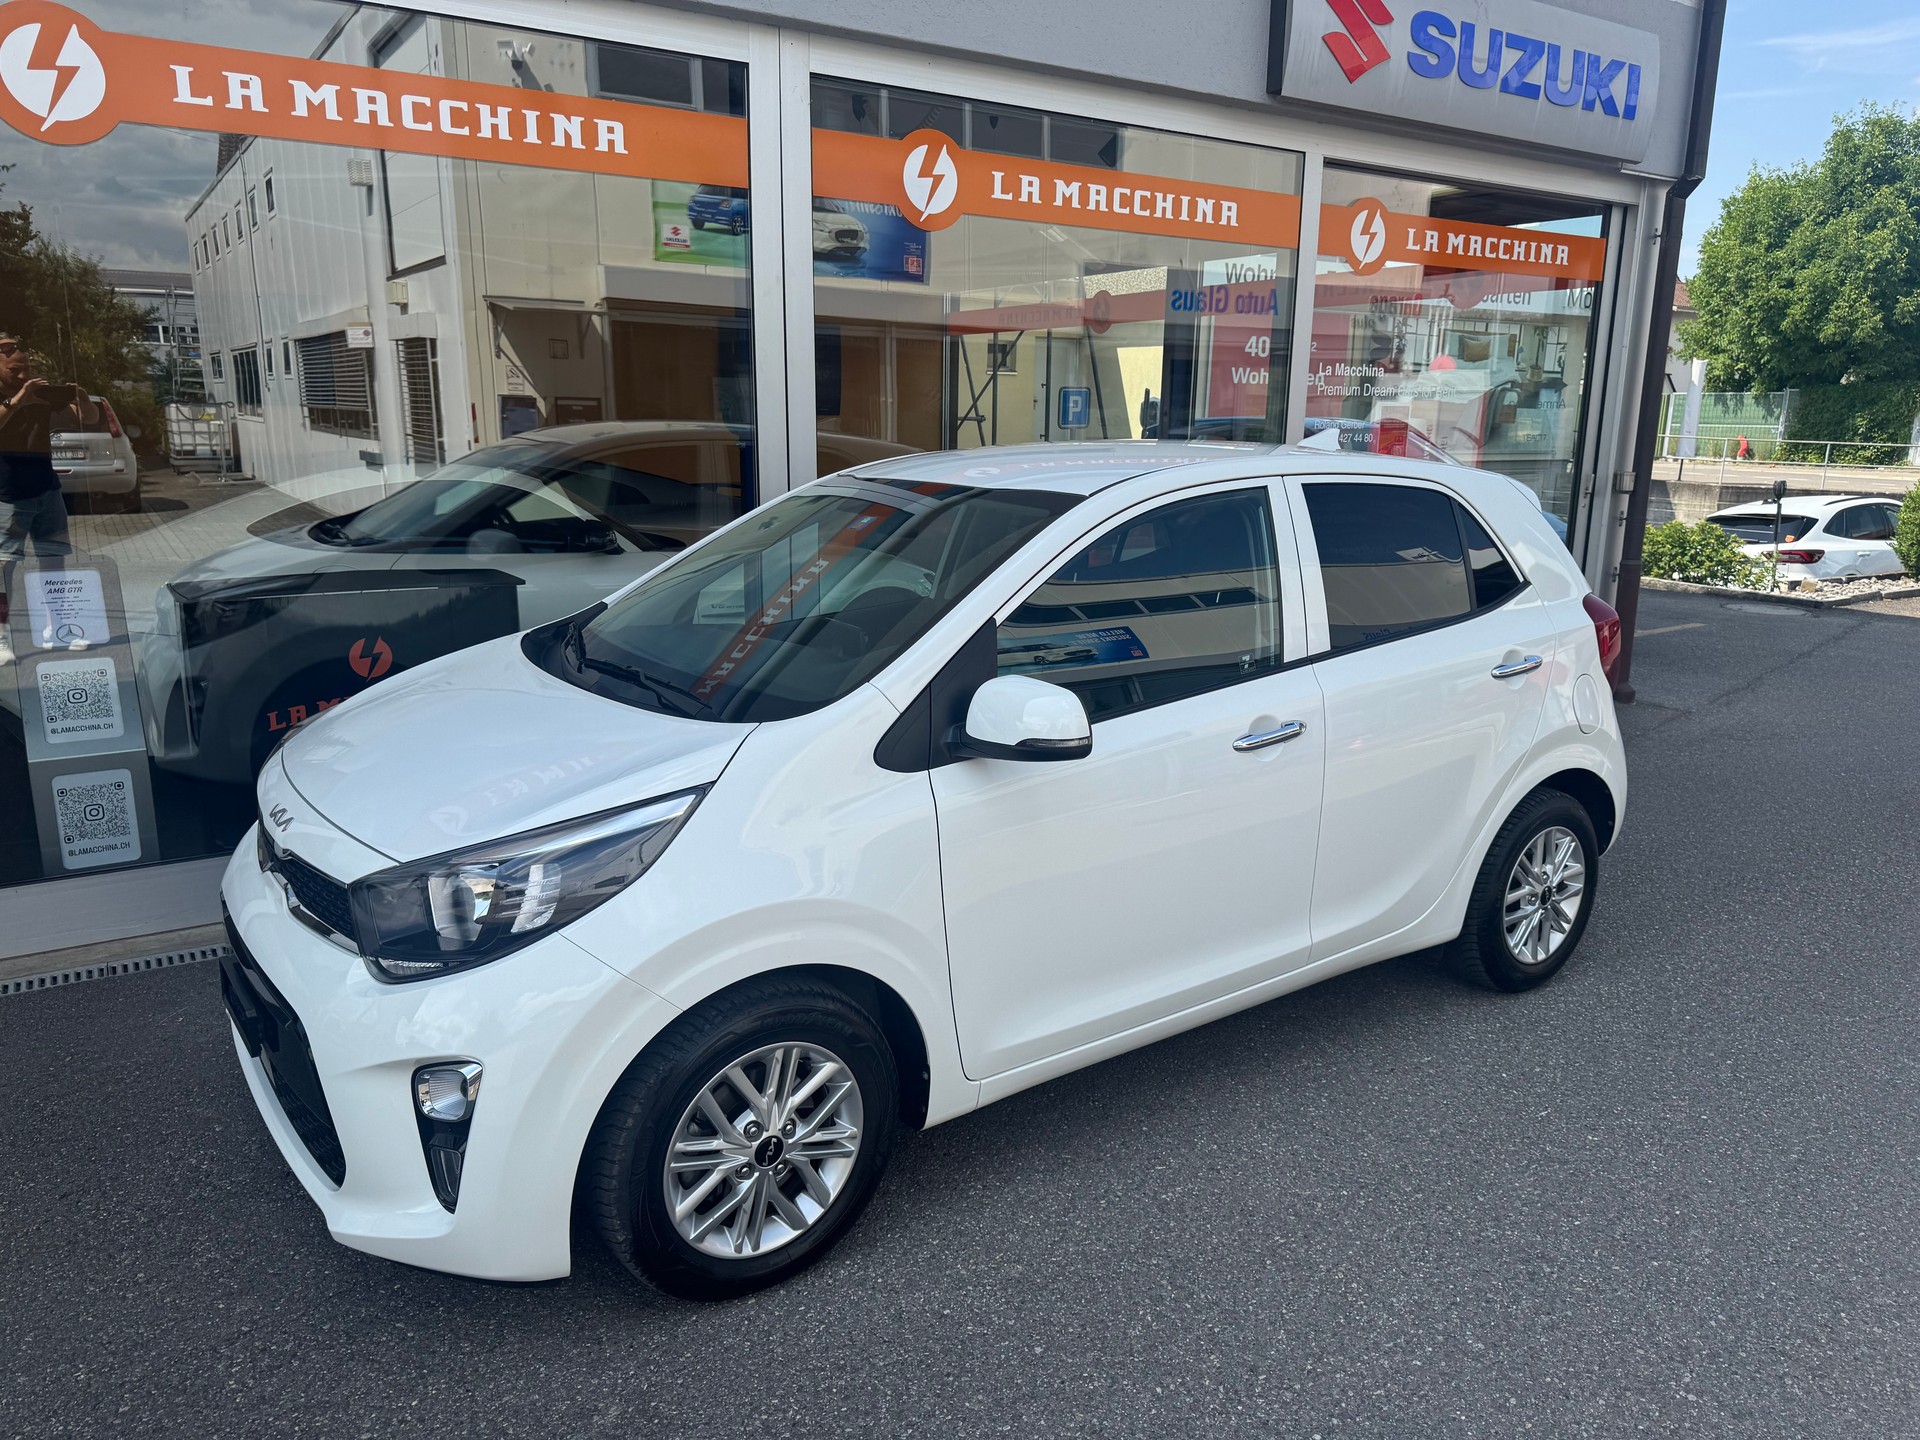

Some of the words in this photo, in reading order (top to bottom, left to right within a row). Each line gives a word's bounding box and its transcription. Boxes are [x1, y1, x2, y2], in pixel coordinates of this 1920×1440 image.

[1407, 10, 1641, 121] SUZUKI
[169, 64, 269, 114] LA
[288, 79, 629, 155] MACCHINA
[991, 171, 1042, 204] LA
[1052, 178, 1239, 227] MACCHINA
[1405, 227, 1439, 253] LA
[1446, 232, 1569, 266] MACCHINA
[1244, 335, 1271, 358] 40
[1318, 362, 1332, 376] La
[1335, 363, 1385, 378] Macchina
[1317, 382, 1361, 396] Premium
[1363, 383, 1395, 397] Dream
[1068, 395, 1082, 421] P
[1353, 433, 1363, 443] 44
[67, 586, 83, 594] GTR
[50, 722, 114, 735] @LAMACCHINA.CH
[68, 841, 131, 857] @LAMACCHINA.CH
